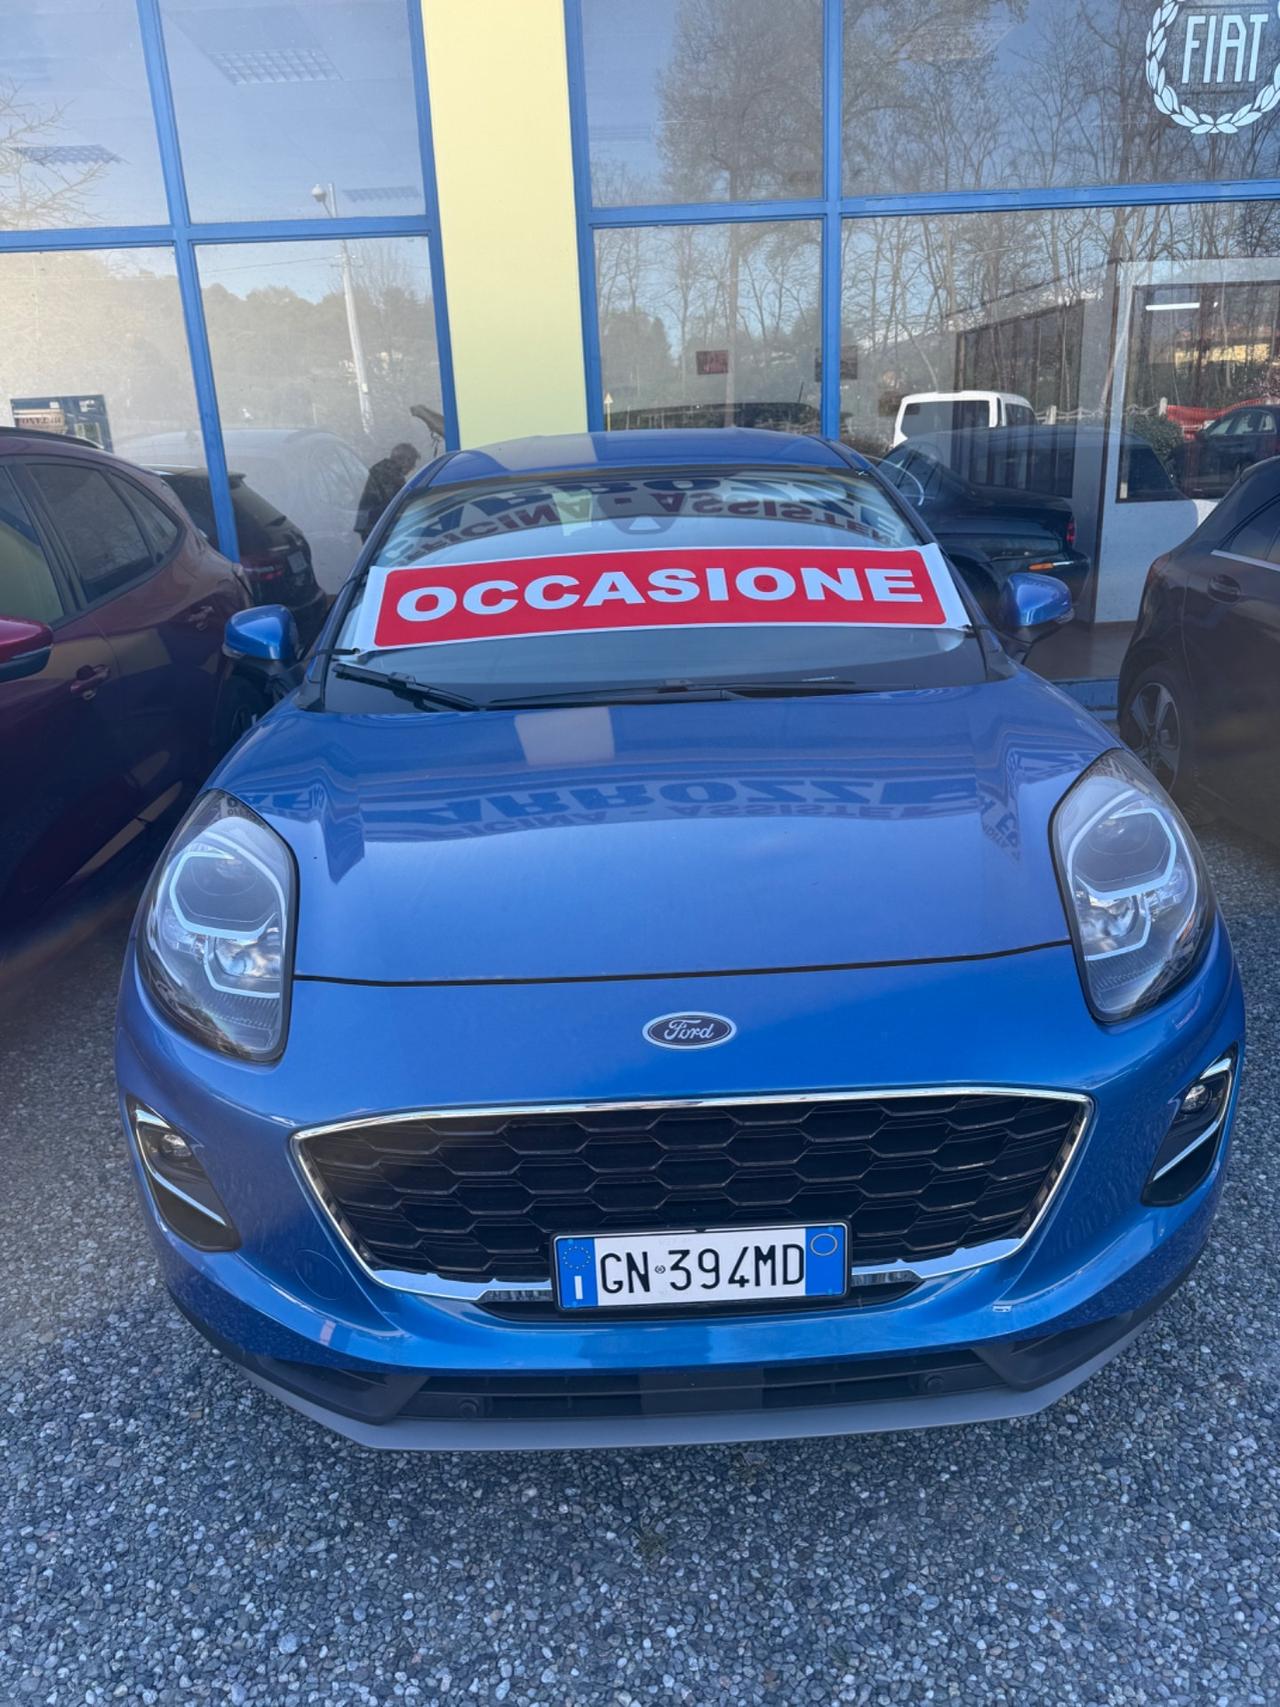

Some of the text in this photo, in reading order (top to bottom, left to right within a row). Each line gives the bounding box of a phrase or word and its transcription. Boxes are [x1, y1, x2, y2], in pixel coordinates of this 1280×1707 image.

[1181, 14, 1269, 84] FIAT
[396, 566, 924, 622] OCCASIONE
[664, 1019, 714, 1040] Ford
